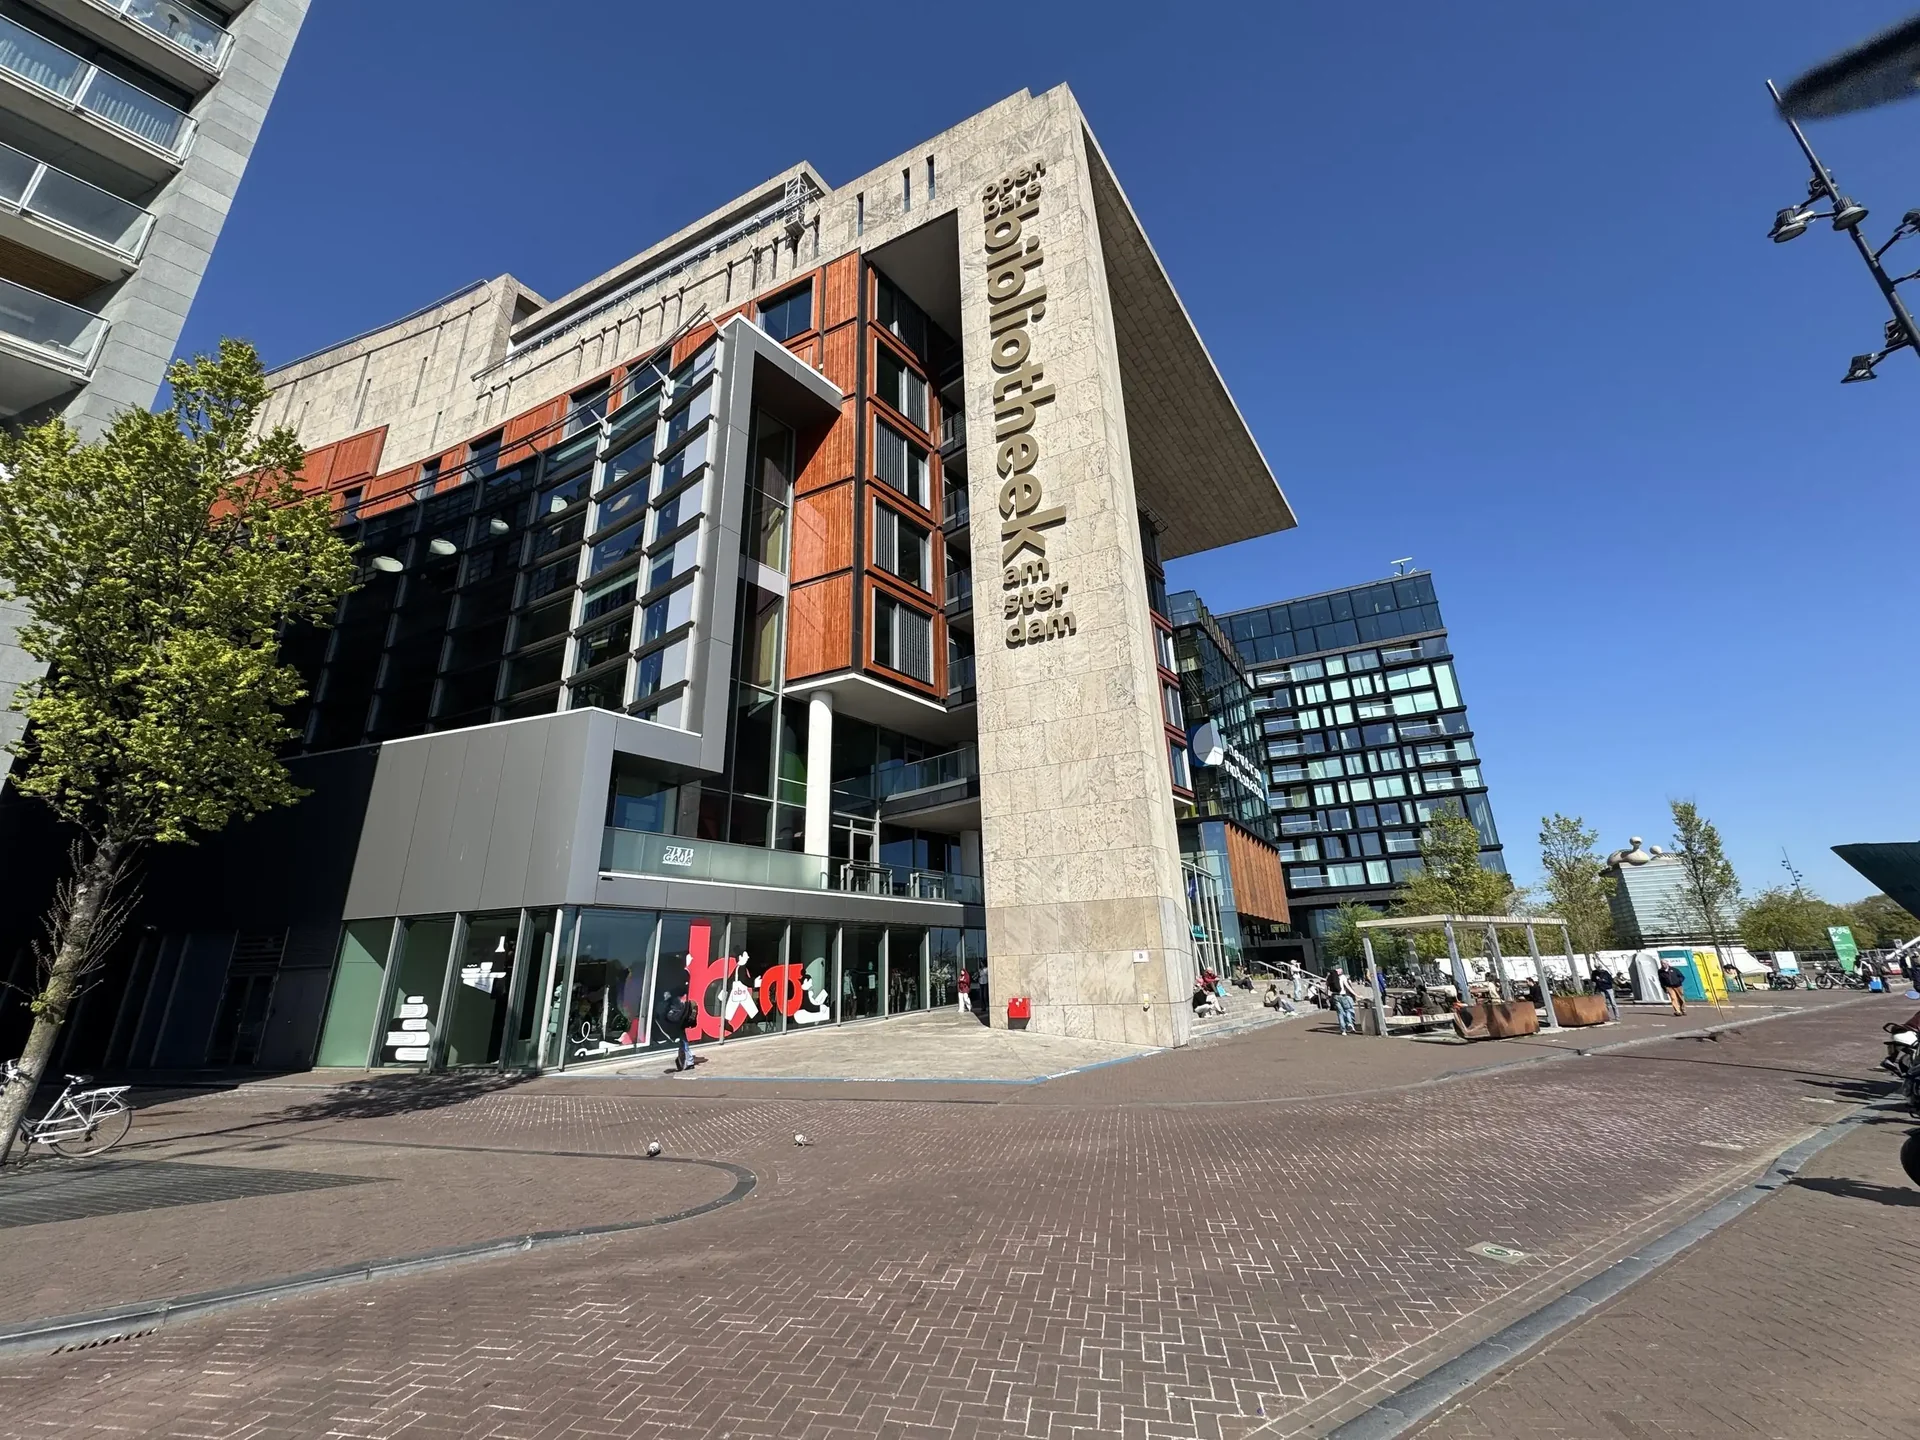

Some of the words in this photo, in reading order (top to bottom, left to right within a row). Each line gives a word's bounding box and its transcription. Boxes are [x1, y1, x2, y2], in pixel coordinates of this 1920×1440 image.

[983, 157, 1046, 201] open
[984, 181, 1042, 219] bare
[984, 200, 1066, 568] bibliotheek
[1003, 558, 1050, 591] am
[1004, 581, 1069, 619] ster
[1005, 611, 1077, 649] dam
